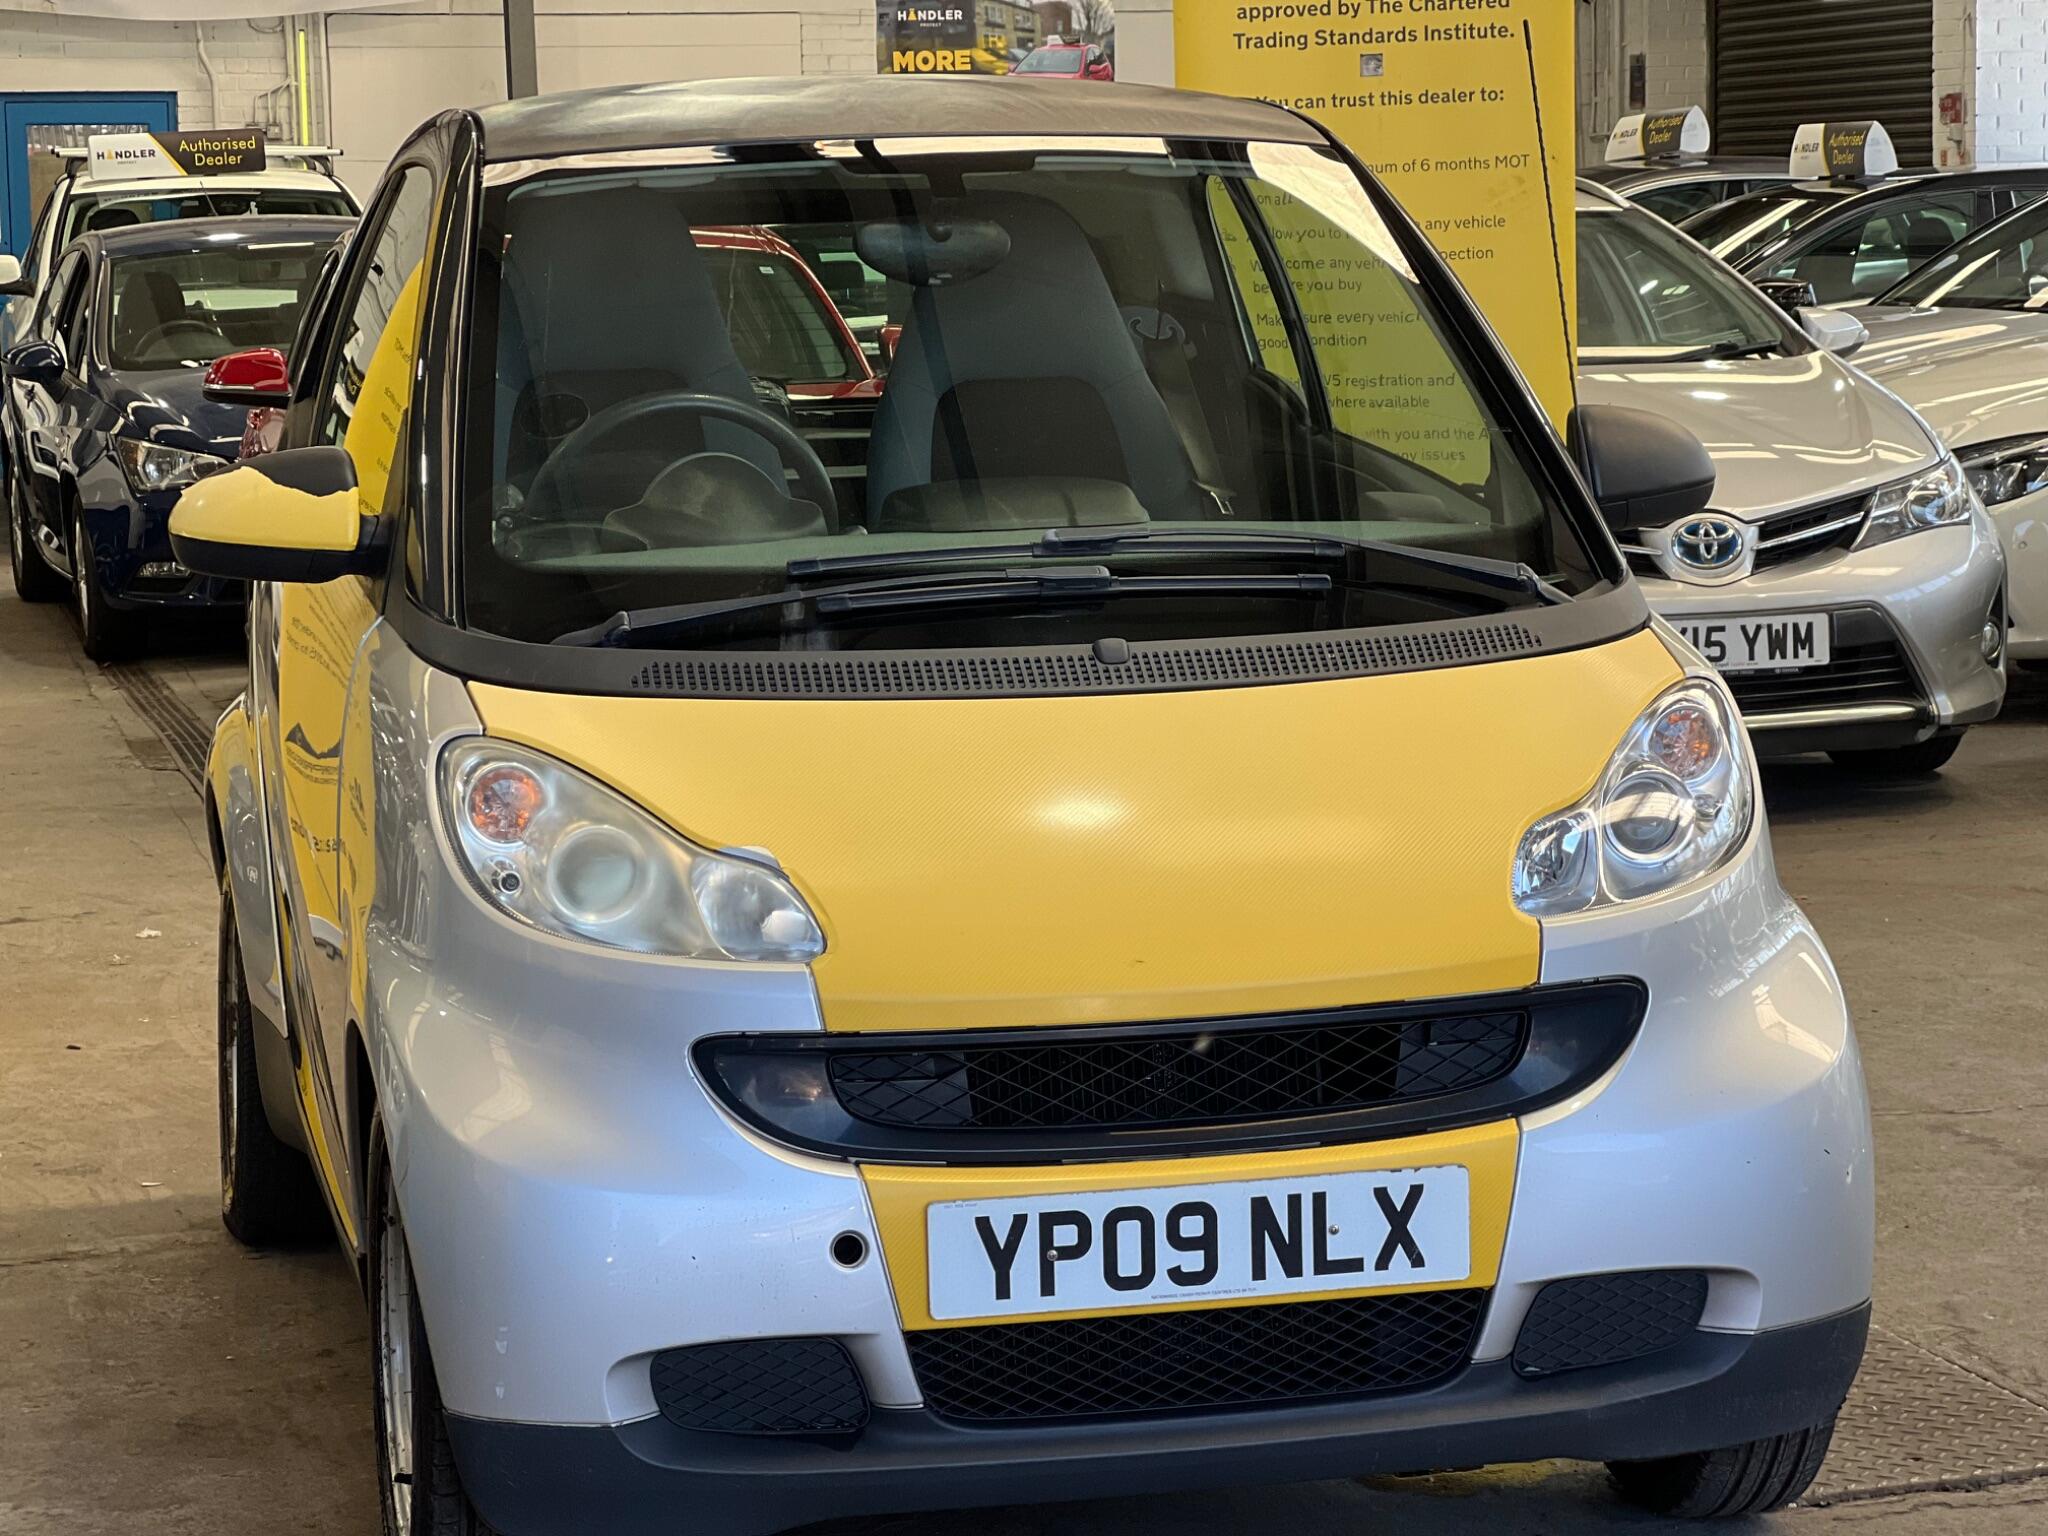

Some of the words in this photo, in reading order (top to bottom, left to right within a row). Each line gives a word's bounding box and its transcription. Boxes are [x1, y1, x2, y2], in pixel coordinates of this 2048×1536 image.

[1236, 0, 1331, 22] approved
[1338, 0, 1361, 18] by
[1366, 0, 1403, 14] The
[1409, 0, 1510, 12] Chartered
[1233, 31, 1308, 50] Trading
[1315, 26, 1418, 46] Standards
[1424, 22, 1515, 42] Institute.
[892, 49, 972, 72] MORE
[1294, 97, 1326, 109] can
[1331, 92, 1375, 108] trust
[1380, 90, 1413, 106] this
[1418, 87, 1475, 104] dealer
[1480, 87, 1504, 101] to:
[179, 136, 256, 152] Authorised
[1829, 131, 1866, 147] Authorised
[195, 153, 242, 166] Dealer
[1402, 159, 1417, 172] of
[1420, 159, 1430, 172] 6
[1435, 157, 1490, 171] months
[1494, 154, 1530, 169] MOT
[1833, 149, 1854, 165] Dealer
[1257, 194, 1271, 205] on
[1425, 220, 1450, 232] any
[1454, 215, 1506, 229] vehicle
[1296, 229, 1325, 243] you
[1328, 227, 1342, 239] to
[1441, 247, 1494, 261] pection
[1330, 258, 1352, 272] any
[1306, 280, 1334, 292] you
[1338, 278, 1362, 292] buy
[1256, 313, 1282, 326] Mak
[1336, 312, 1374, 325] every
[1258, 337, 1288, 350] good
[1311, 333, 1368, 347] ondition
[1345, 373, 1423, 389] registration
[1427, 373, 1455, 386] and
[1369, 395, 1430, 408] available
[1395, 430, 1420, 442] you
[1423, 427, 1450, 440] and
[1454, 427, 1475, 439] the
[1420, 447, 1466, 461] issues
[1740, 621, 1814, 661] YWM
[974, 1202, 1218, 1301] YP09
[1250, 1183, 1425, 1282] NLX
